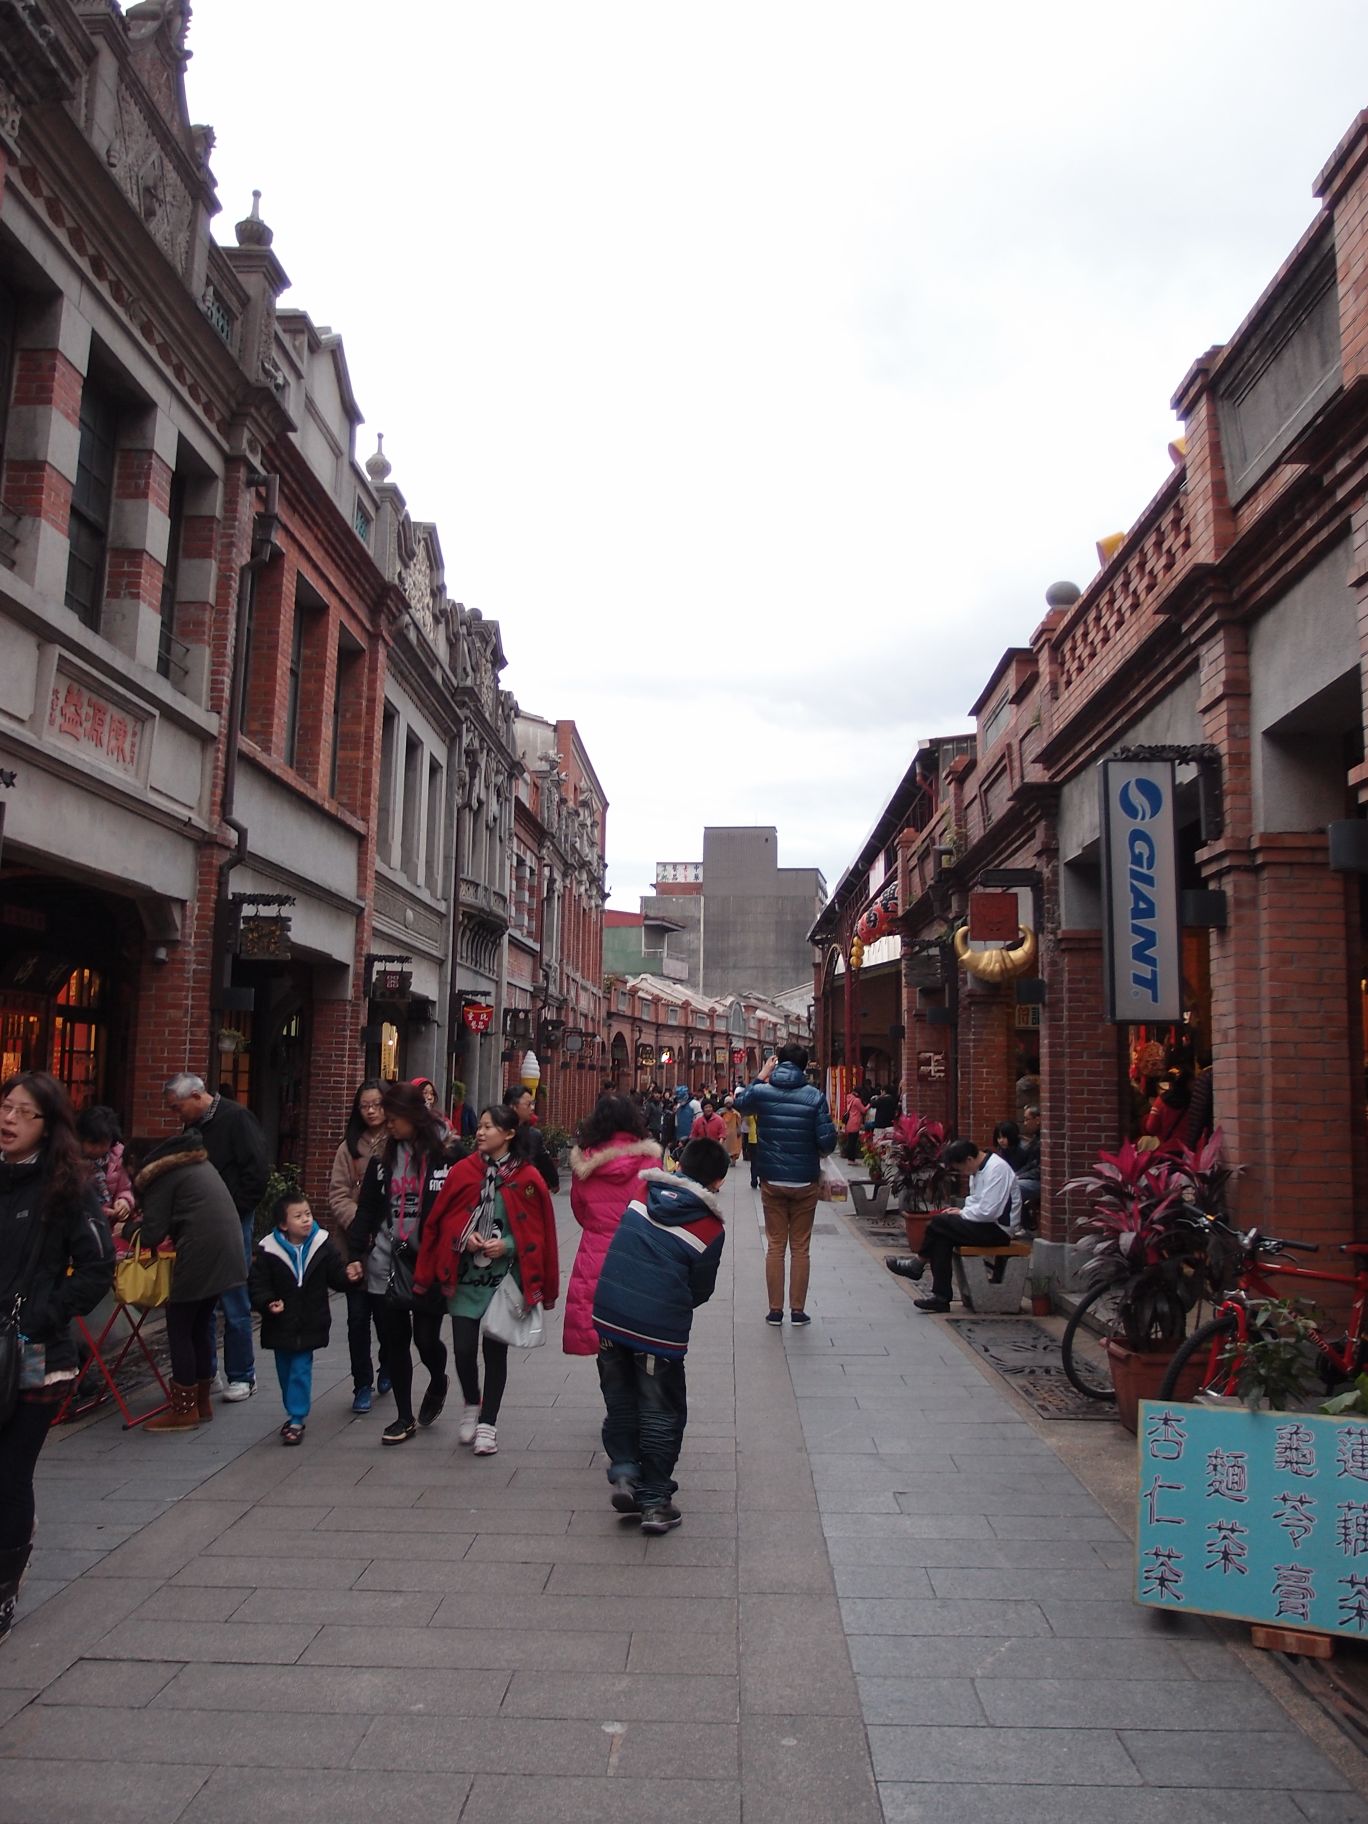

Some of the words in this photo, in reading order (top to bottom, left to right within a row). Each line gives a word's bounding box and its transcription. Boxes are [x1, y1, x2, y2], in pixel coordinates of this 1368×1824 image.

[1128, 828, 1159, 1004] GIANT
[1142, 1410, 1188, 1602] 杏仁茶
[1203, 1447, 1249, 1575] 麵茶
[1272, 1422, 1319, 1622] 龜苓膏
[1335, 1426, 1368, 1632] 蓮藕茶
